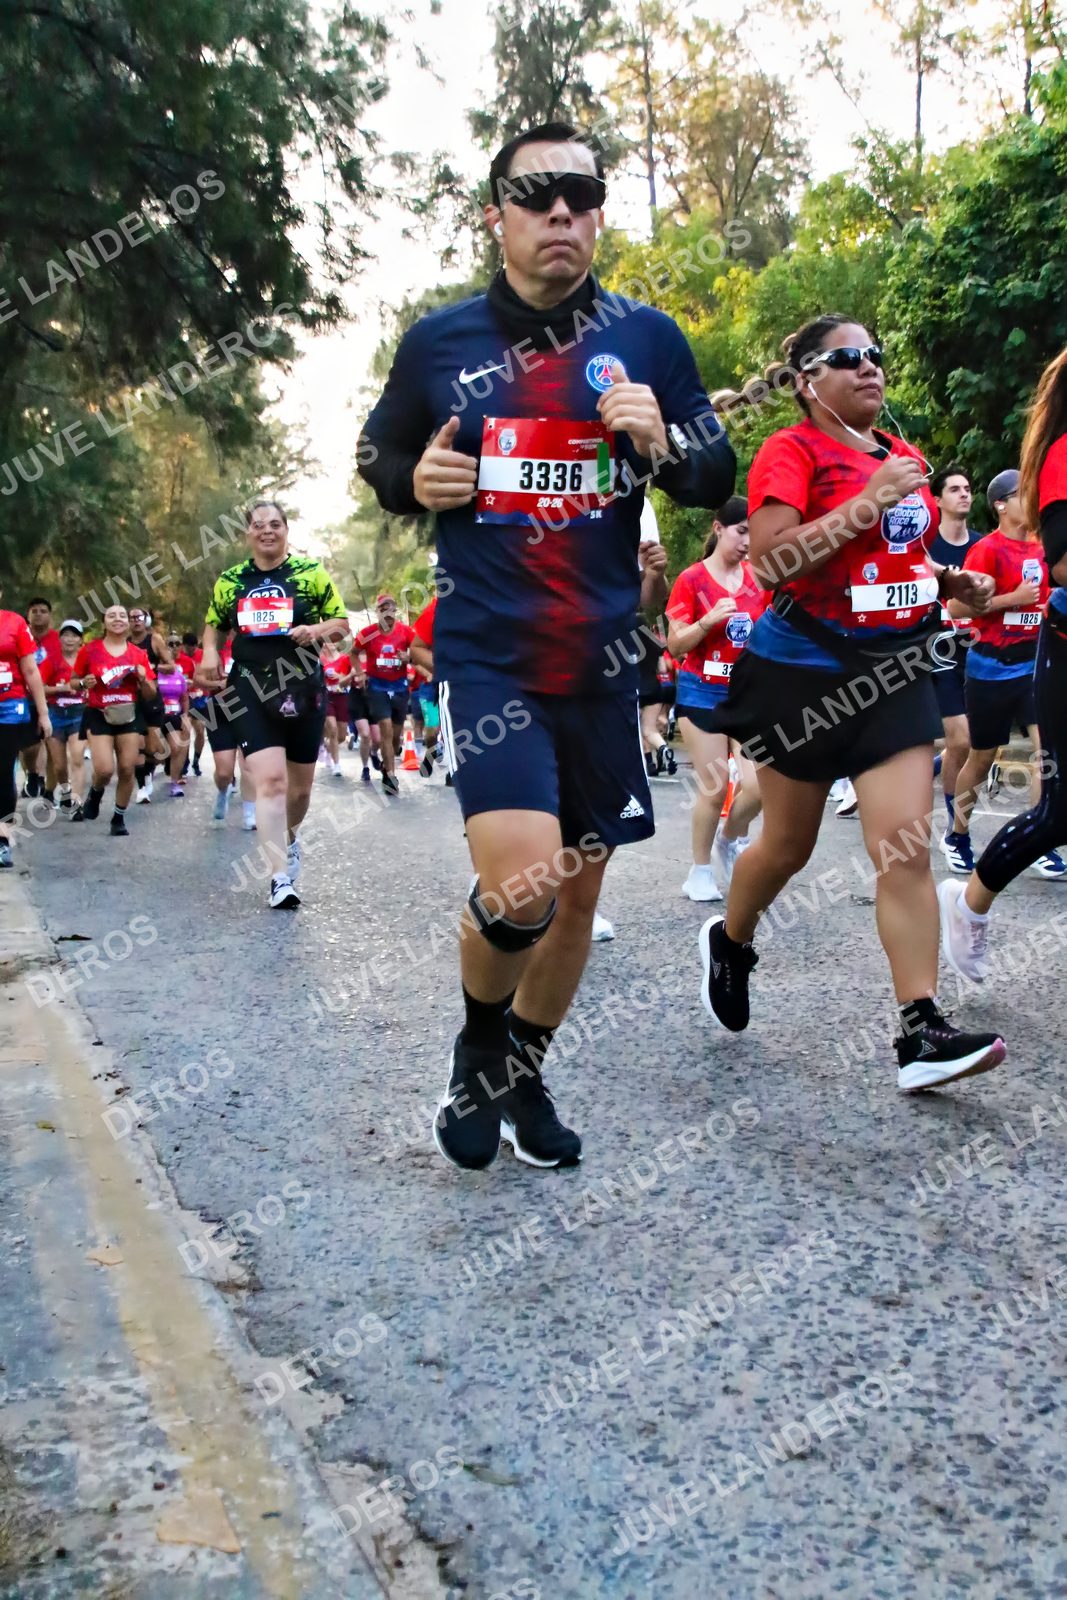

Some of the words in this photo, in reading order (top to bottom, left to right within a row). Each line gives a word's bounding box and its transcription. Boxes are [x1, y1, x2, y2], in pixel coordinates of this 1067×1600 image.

[519, 461, 583, 492] 3336
[537, 497, 564, 508] 20-26
[894, 507, 919, 518] Global
[889, 516, 910, 526] Race
[886, 583, 918, 608] 2113
[252, 611, 275, 623] 1825
[1020, 613, 1038, 624] 1826
[620, 807, 645, 819] adidas
